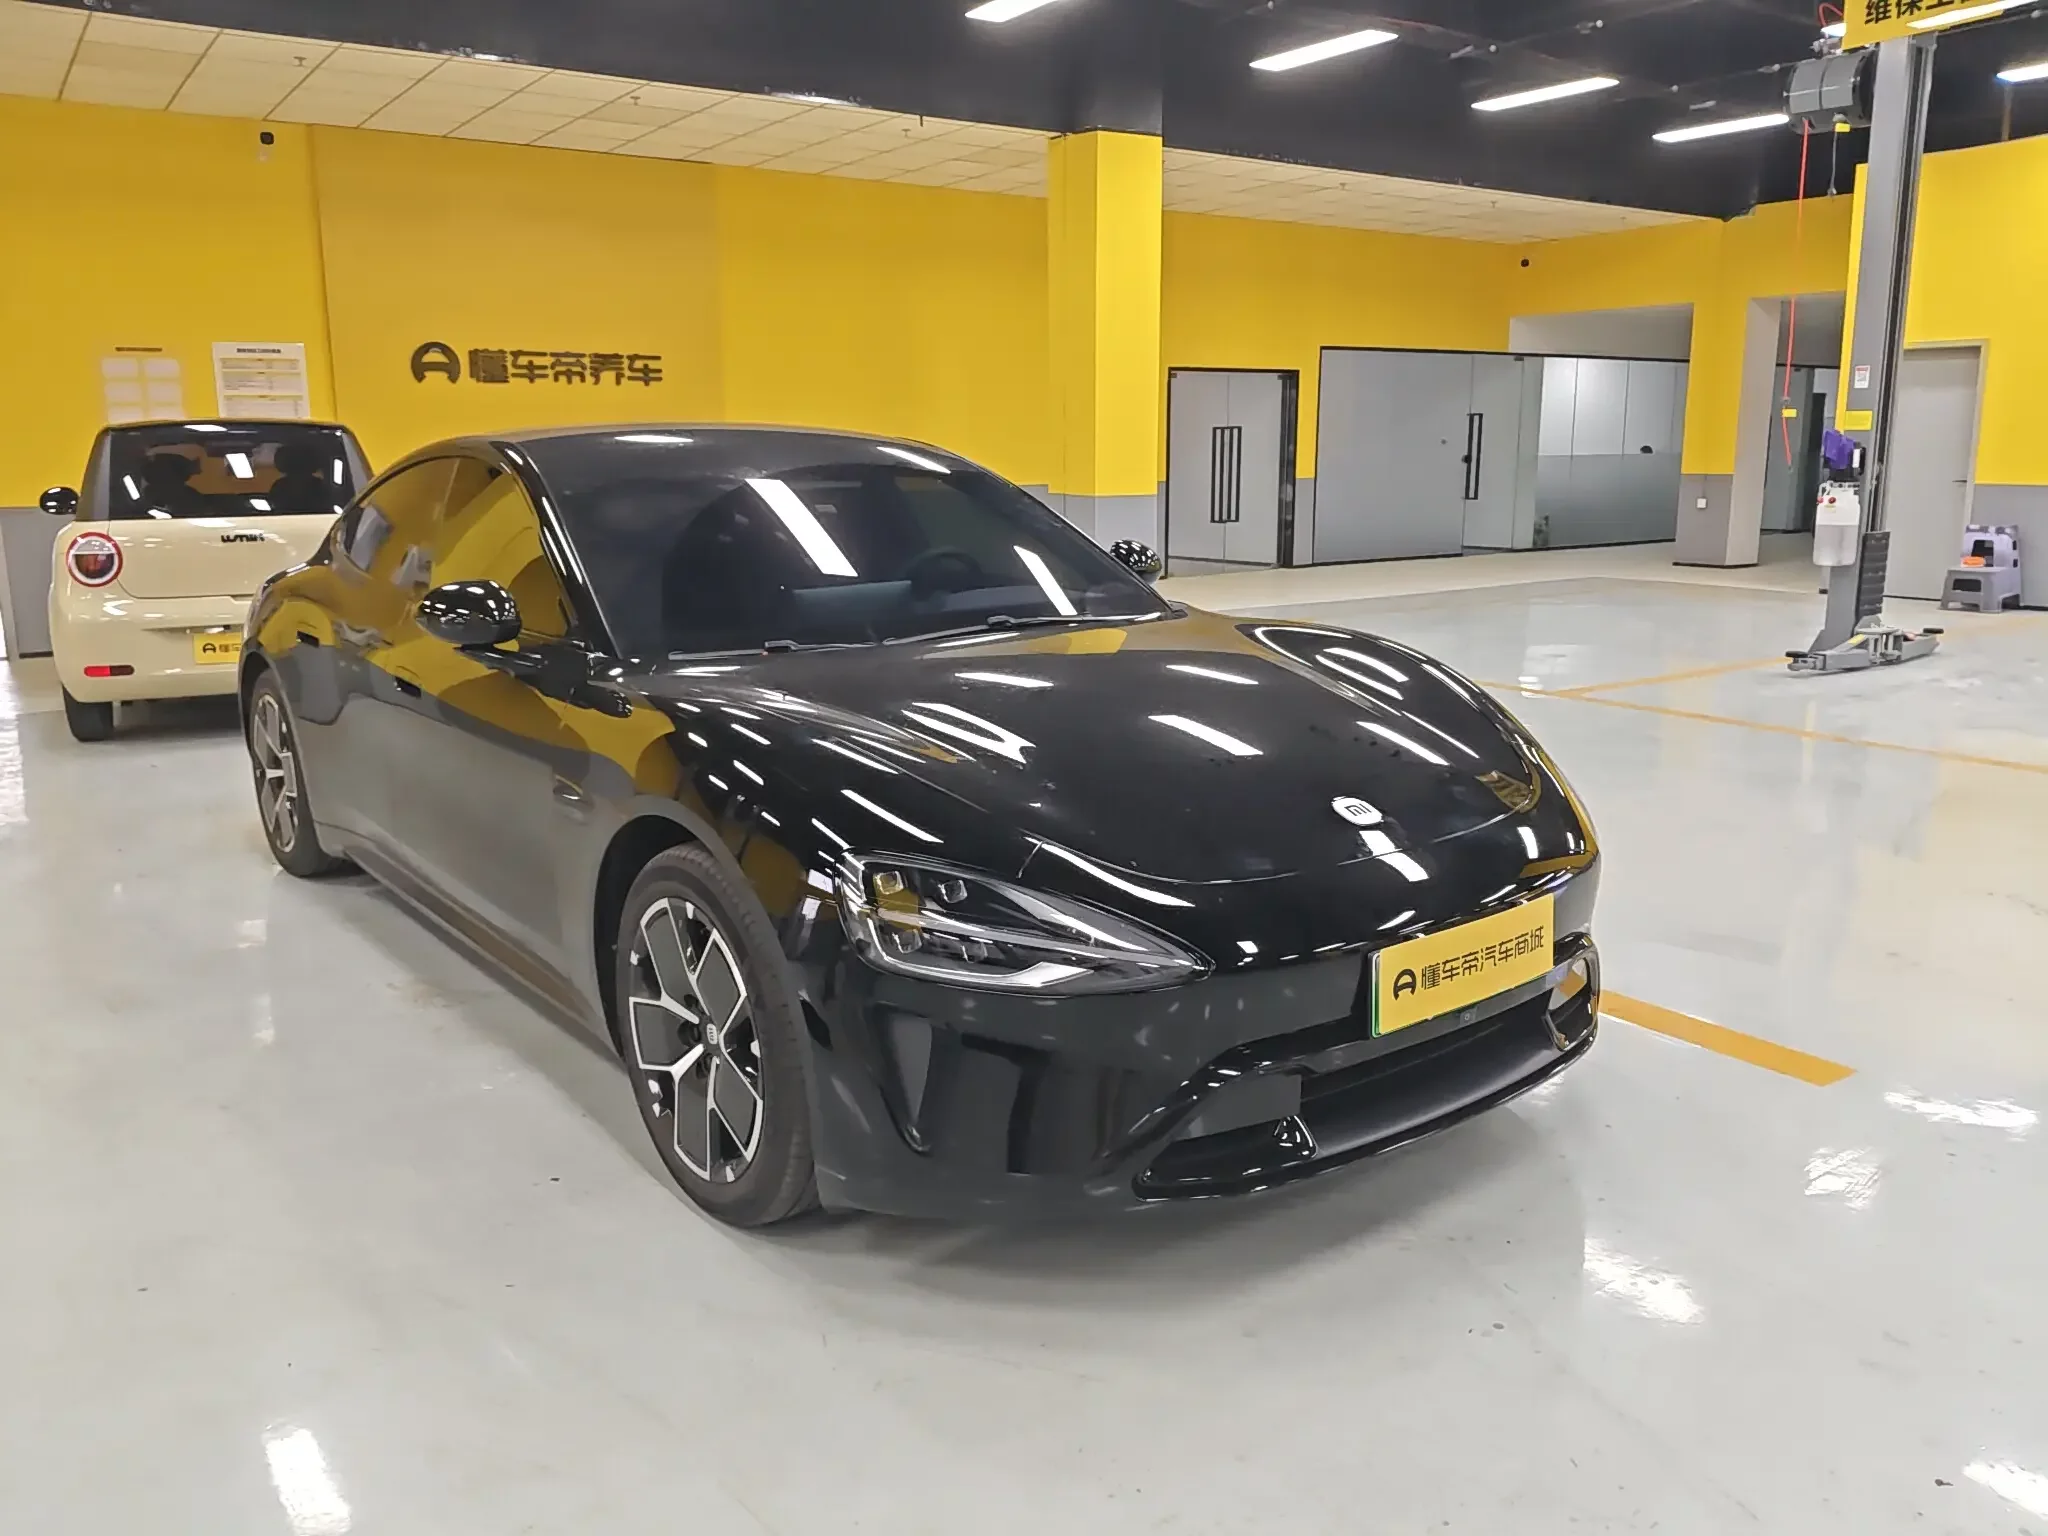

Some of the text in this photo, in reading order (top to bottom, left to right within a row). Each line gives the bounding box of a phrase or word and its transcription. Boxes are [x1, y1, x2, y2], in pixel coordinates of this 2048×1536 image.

[1421, 925, 1544, 990] 懂车帝汽车商城
